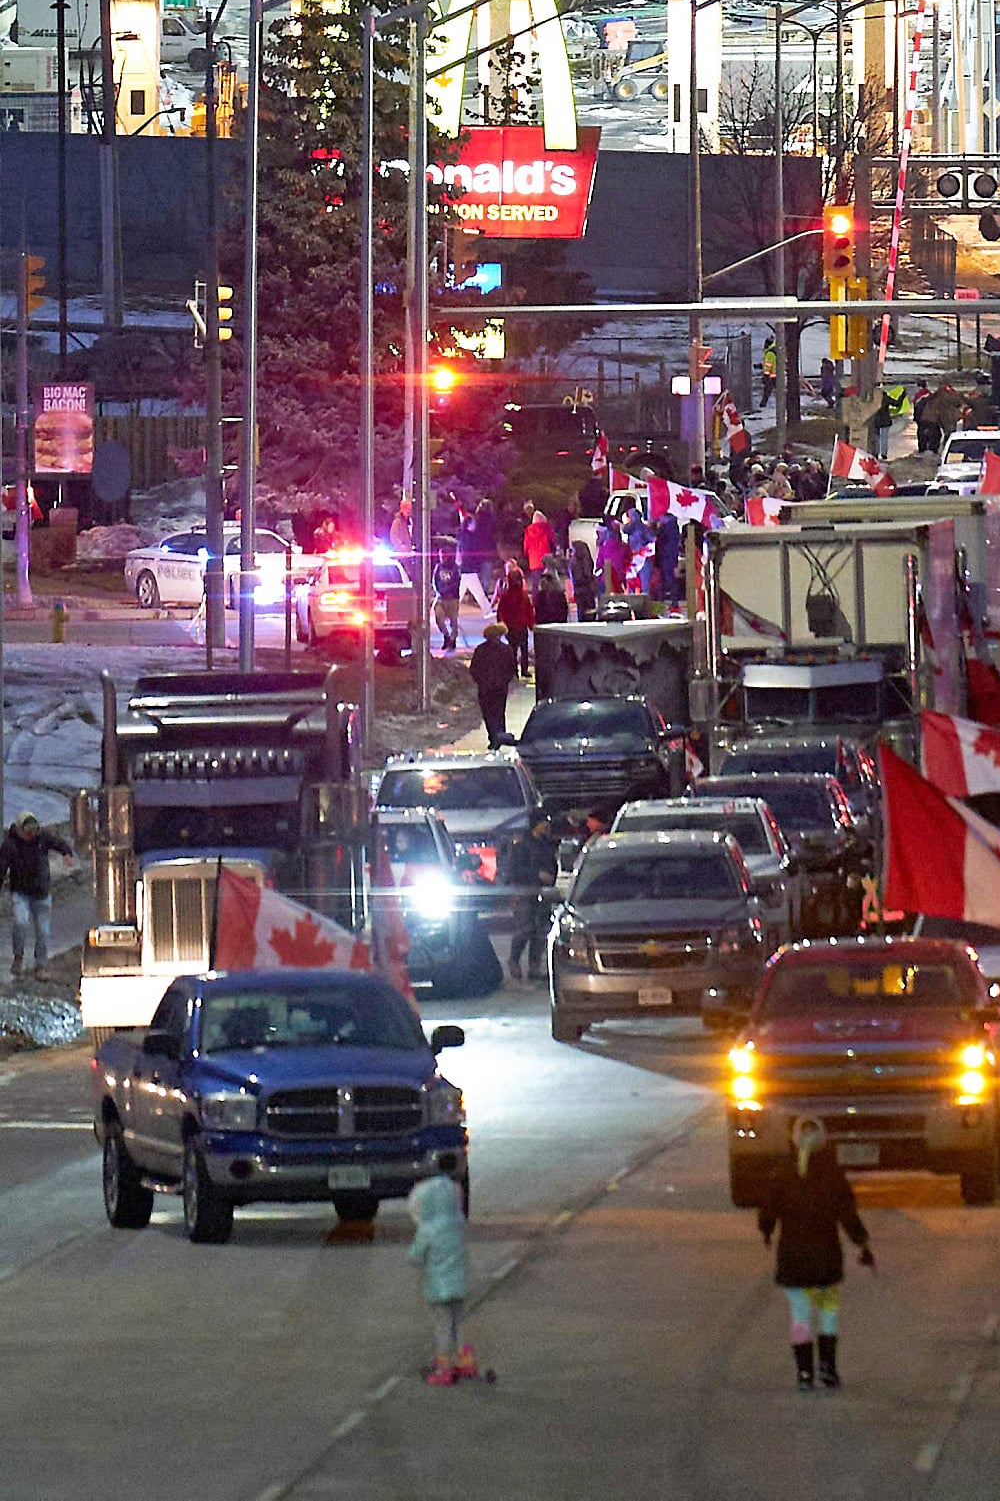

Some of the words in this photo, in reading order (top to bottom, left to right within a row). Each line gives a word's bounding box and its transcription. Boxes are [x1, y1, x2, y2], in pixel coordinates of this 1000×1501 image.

[487, 204, 559, 222] SERVED
[43, 386, 62, 399] BIG
[62, 386, 86, 399] MAC
[43, 399, 86, 412] BACON!
[157, 564, 197, 581] POLICE
